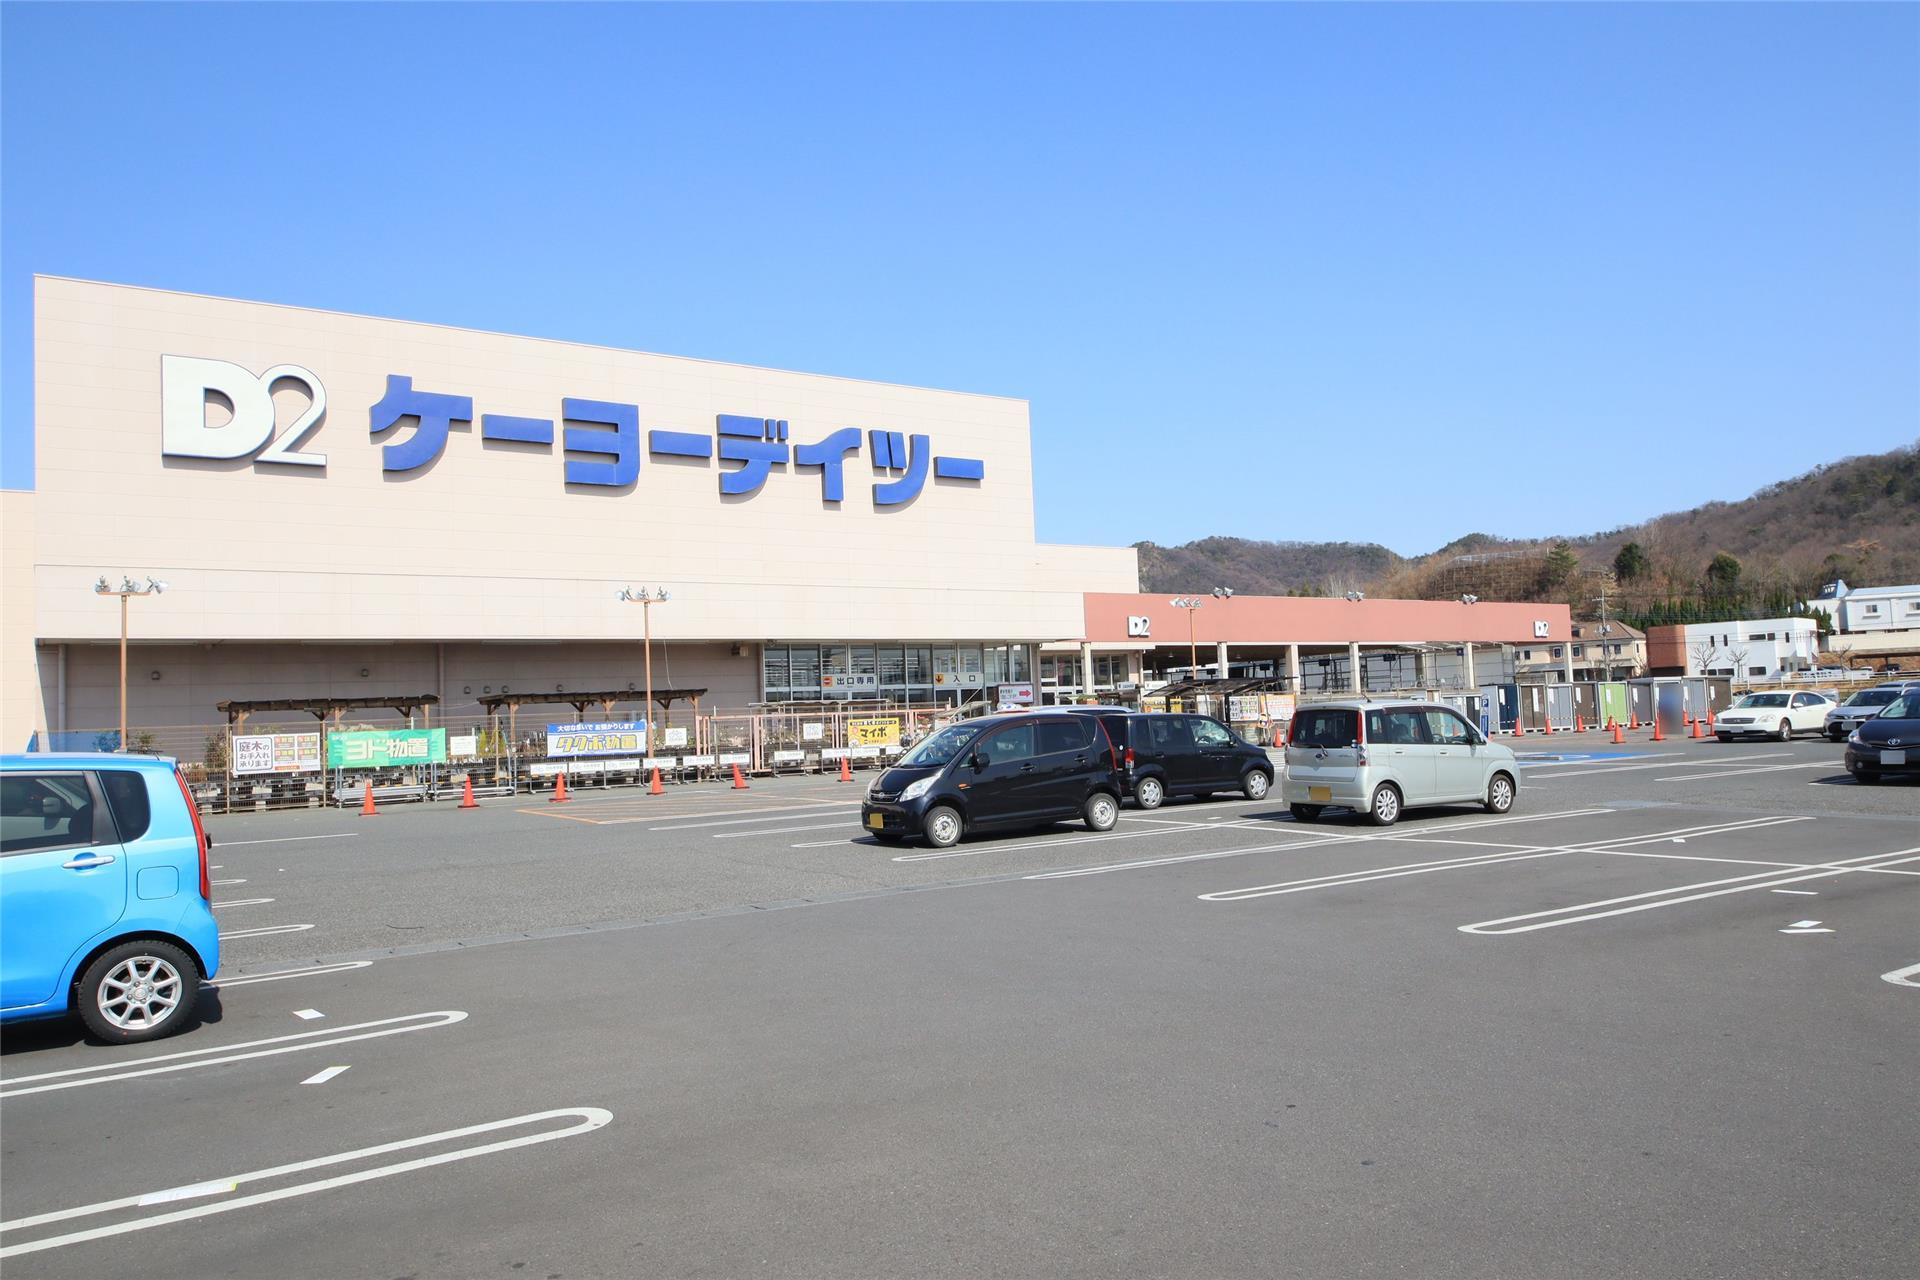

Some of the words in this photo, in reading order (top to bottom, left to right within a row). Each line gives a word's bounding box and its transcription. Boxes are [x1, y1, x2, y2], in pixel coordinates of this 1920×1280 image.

[161, 353, 327, 467] D2
[369, 374, 985, 507] ケーヨーデイツー
[1128, 615, 1151, 638] D2
[1533, 619, 1550, 638] D2
[836, 676, 875, 686] 出口専用
[953, 674, 976, 683] 入口
[239, 741, 271, 752] 庭木の
[342, 737, 429, 761] ヨド物置
[239, 752, 271, 760] お手入れ
[239, 760, 271, 768] 承ります
